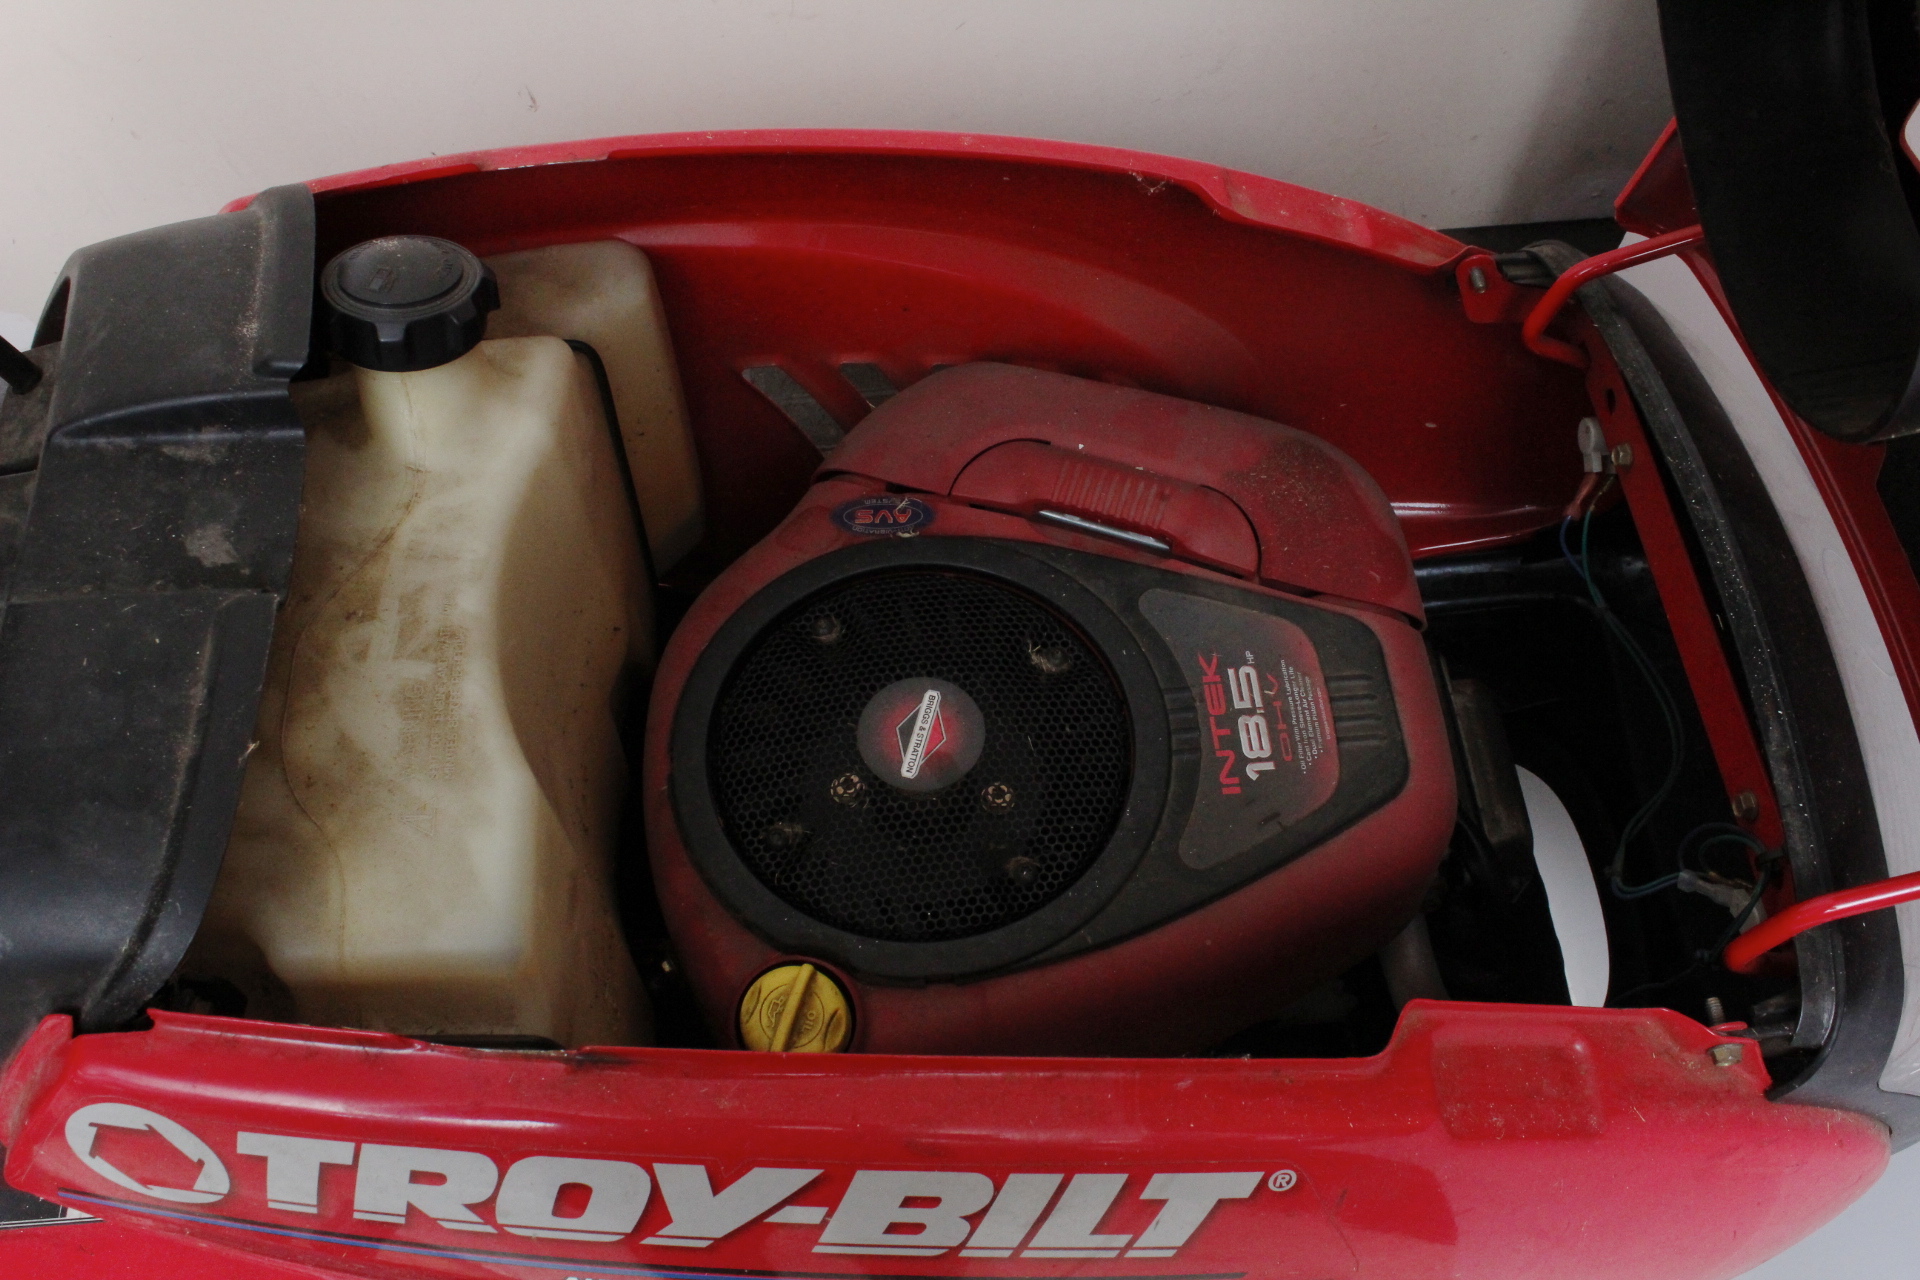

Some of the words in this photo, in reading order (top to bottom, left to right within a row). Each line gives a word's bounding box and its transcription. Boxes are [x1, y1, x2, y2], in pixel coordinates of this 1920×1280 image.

[854, 508, 912, 524] AVS
[1245, 650, 1255, 665] HP
[1280, 659, 1291, 695] Lubrication
[1288, 666, 1296, 680] Life
[1296, 671, 1307, 698] Cleaner
[1303, 675, 1314, 701] Package
[921, 694, 936, 725] BRIGGS
[1288, 695, 1298, 725] Pressure
[1301, 697, 1309, 709] Air
[1309, 701, 1318, 721] Piston
[1198, 652, 1242, 795] INTEK
[1227, 665, 1276, 781] 18.5
[1264, 672, 1293, 762] OHV
[1303, 708, 1315, 738] Element
[1293, 726, 1301, 742] With
[1300, 728, 1309, 744] Iron
[1309, 737, 1318, 755] Dual
[1313, 720, 1323, 749] Premium
[905, 732, 924, 774] STRATTON
[1297, 741, 1305, 760] Filter
[1304, 744, 1313, 762] Cast
[801, 1010, 816, 1032] OIL
[236, 1131, 1264, 1259] TROY-BILT
